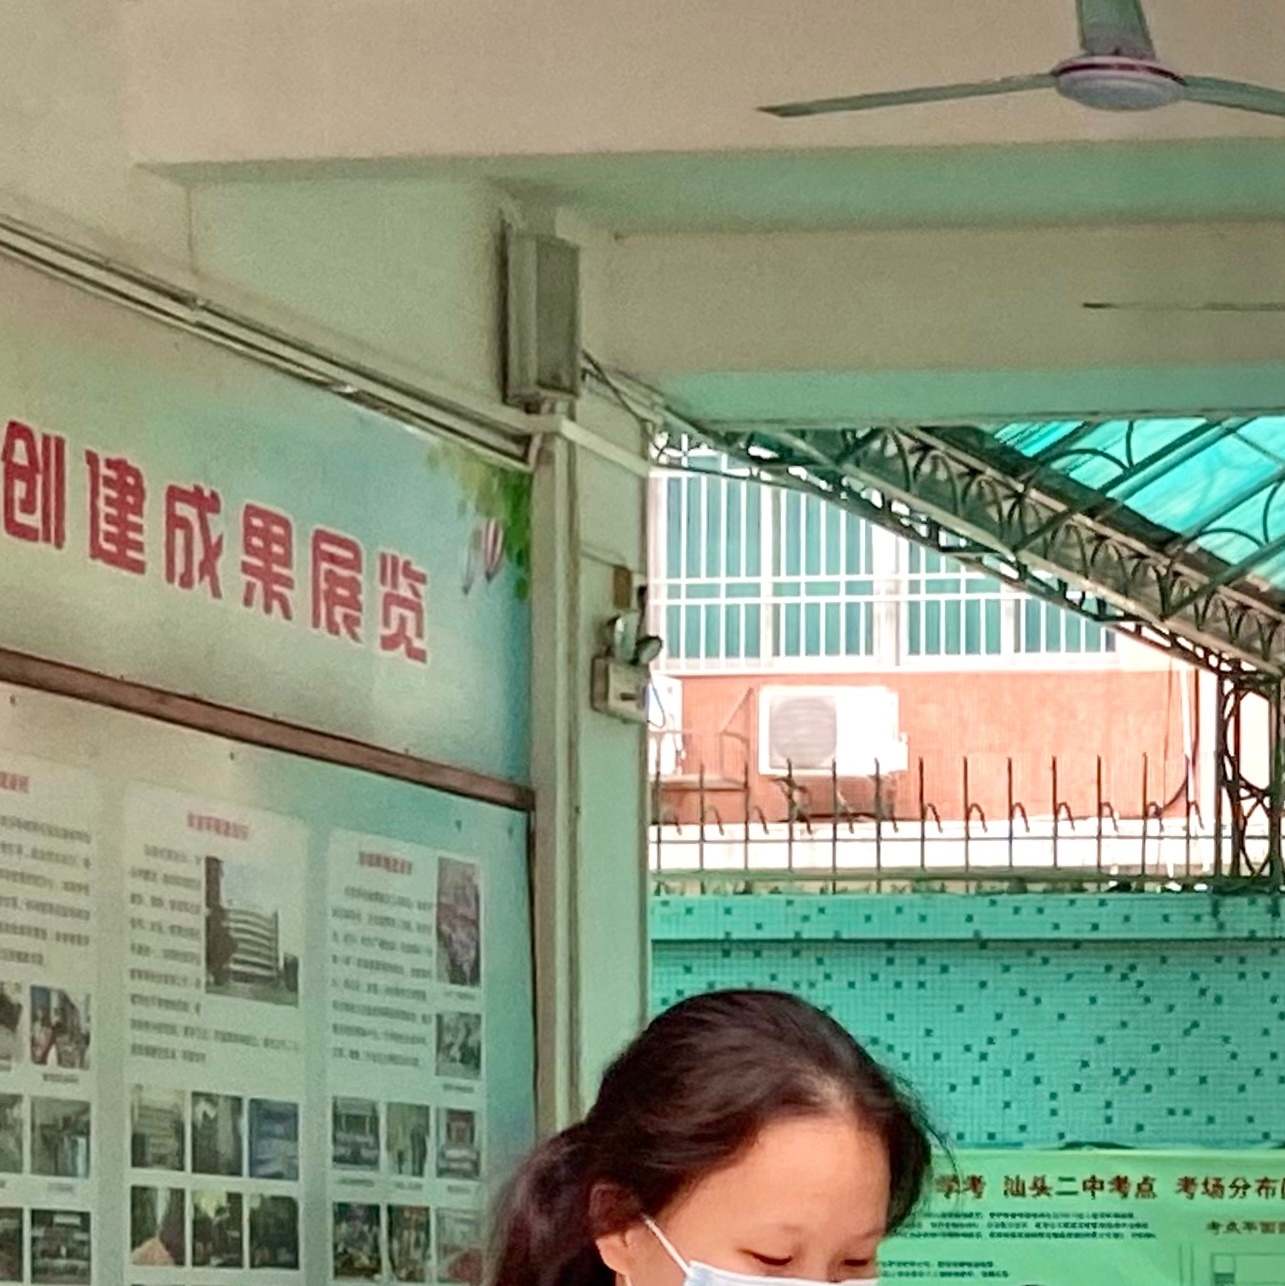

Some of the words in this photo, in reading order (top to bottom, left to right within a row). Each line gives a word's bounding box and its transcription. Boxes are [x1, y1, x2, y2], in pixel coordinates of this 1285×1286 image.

[1, 420, 428, 664] 创建成果展览
[1003, 1174, 1157, 1199] 汕头二中考点
